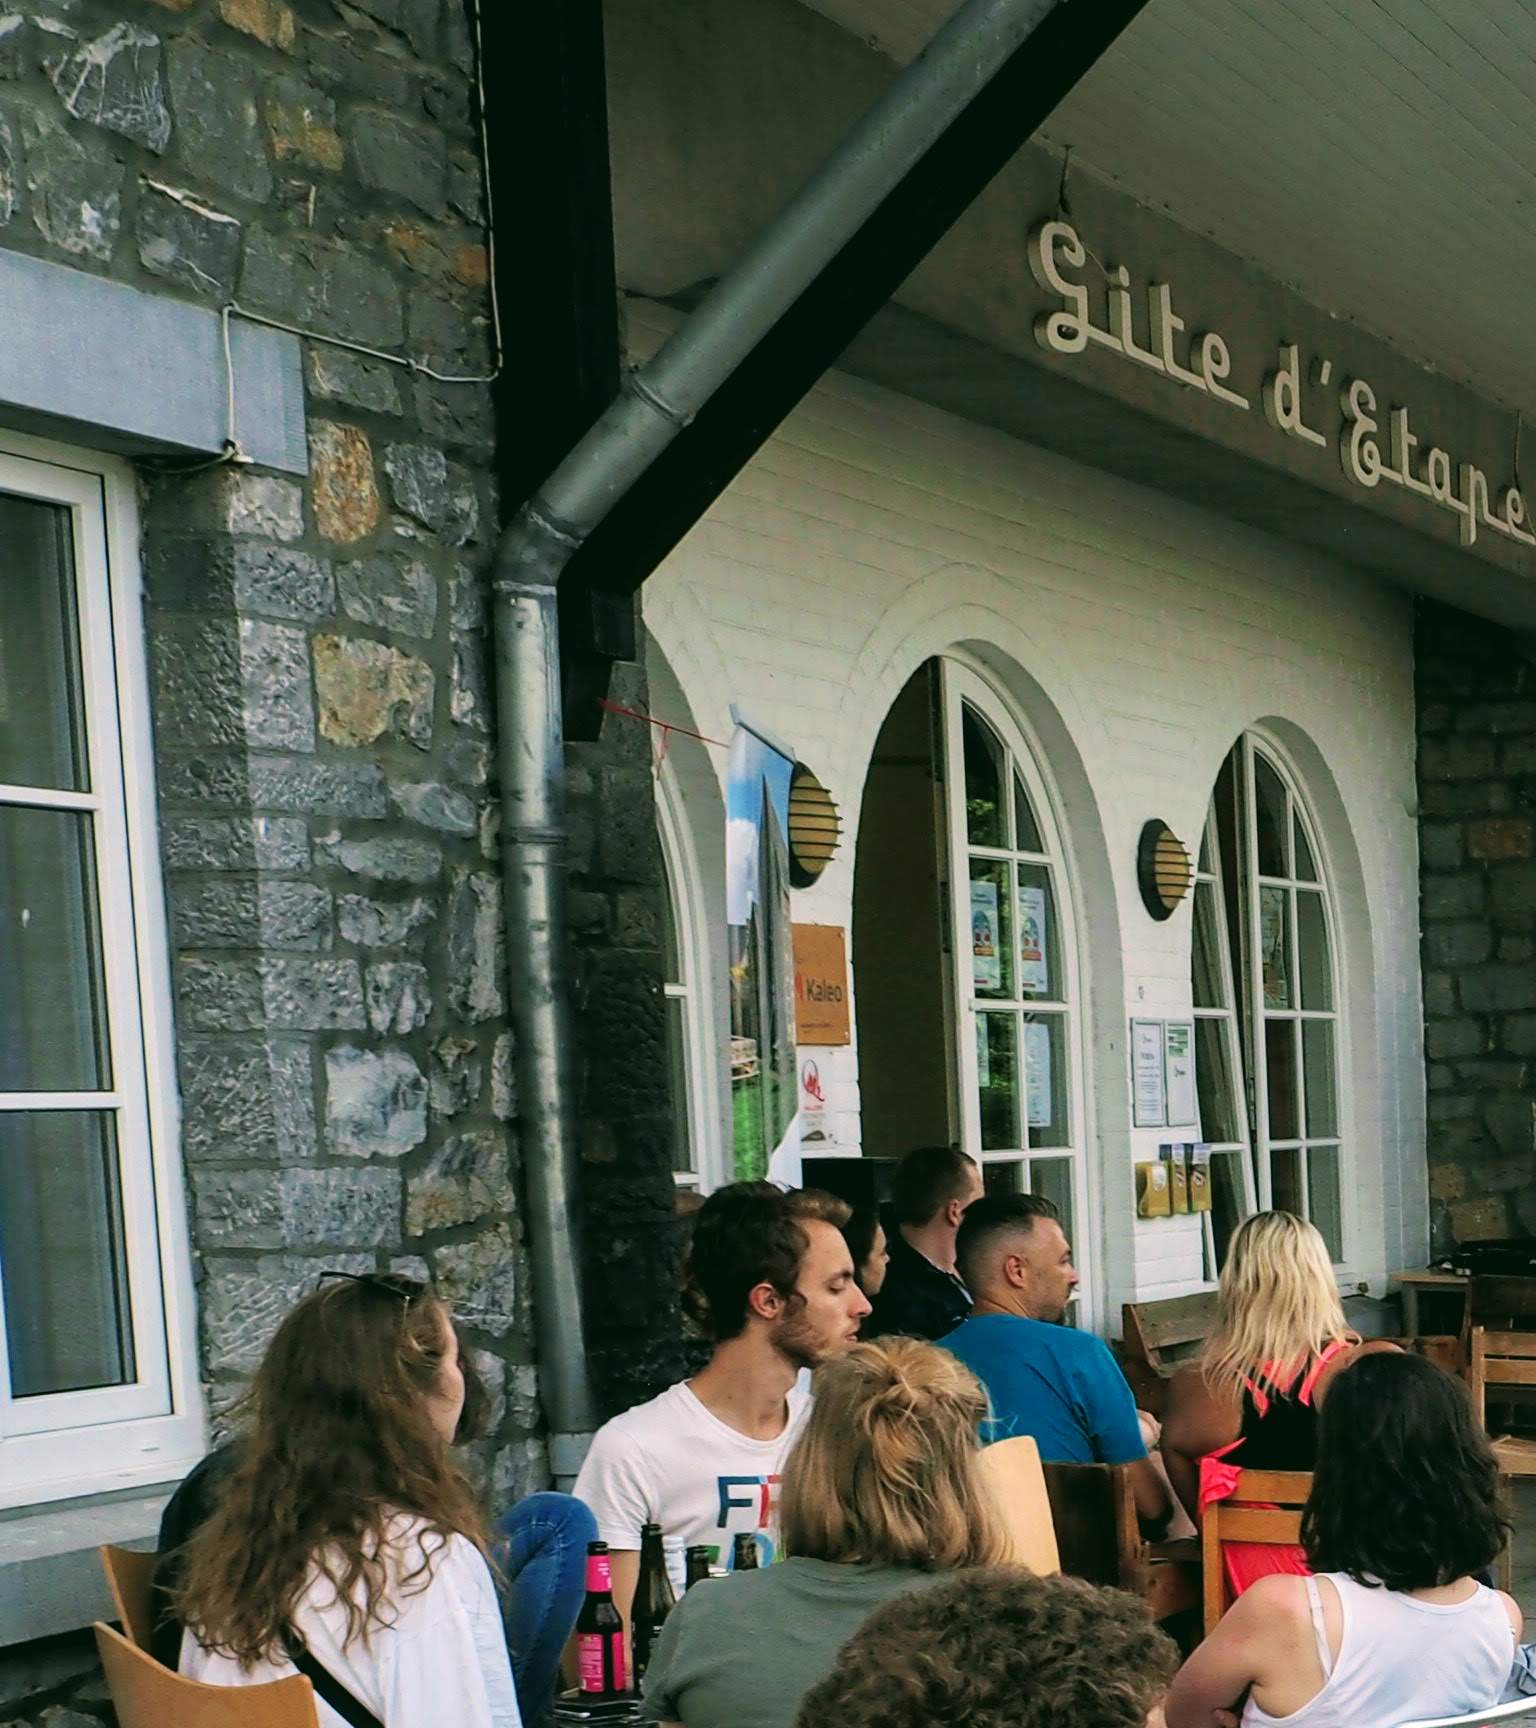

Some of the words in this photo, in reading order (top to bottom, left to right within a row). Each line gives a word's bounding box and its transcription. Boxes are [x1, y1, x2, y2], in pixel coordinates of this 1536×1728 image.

[1028, 221, 1249, 409] Gite
[1263, 344, 1536, 546] d'Etape
[806, 979, 843, 1002] Kaleo
